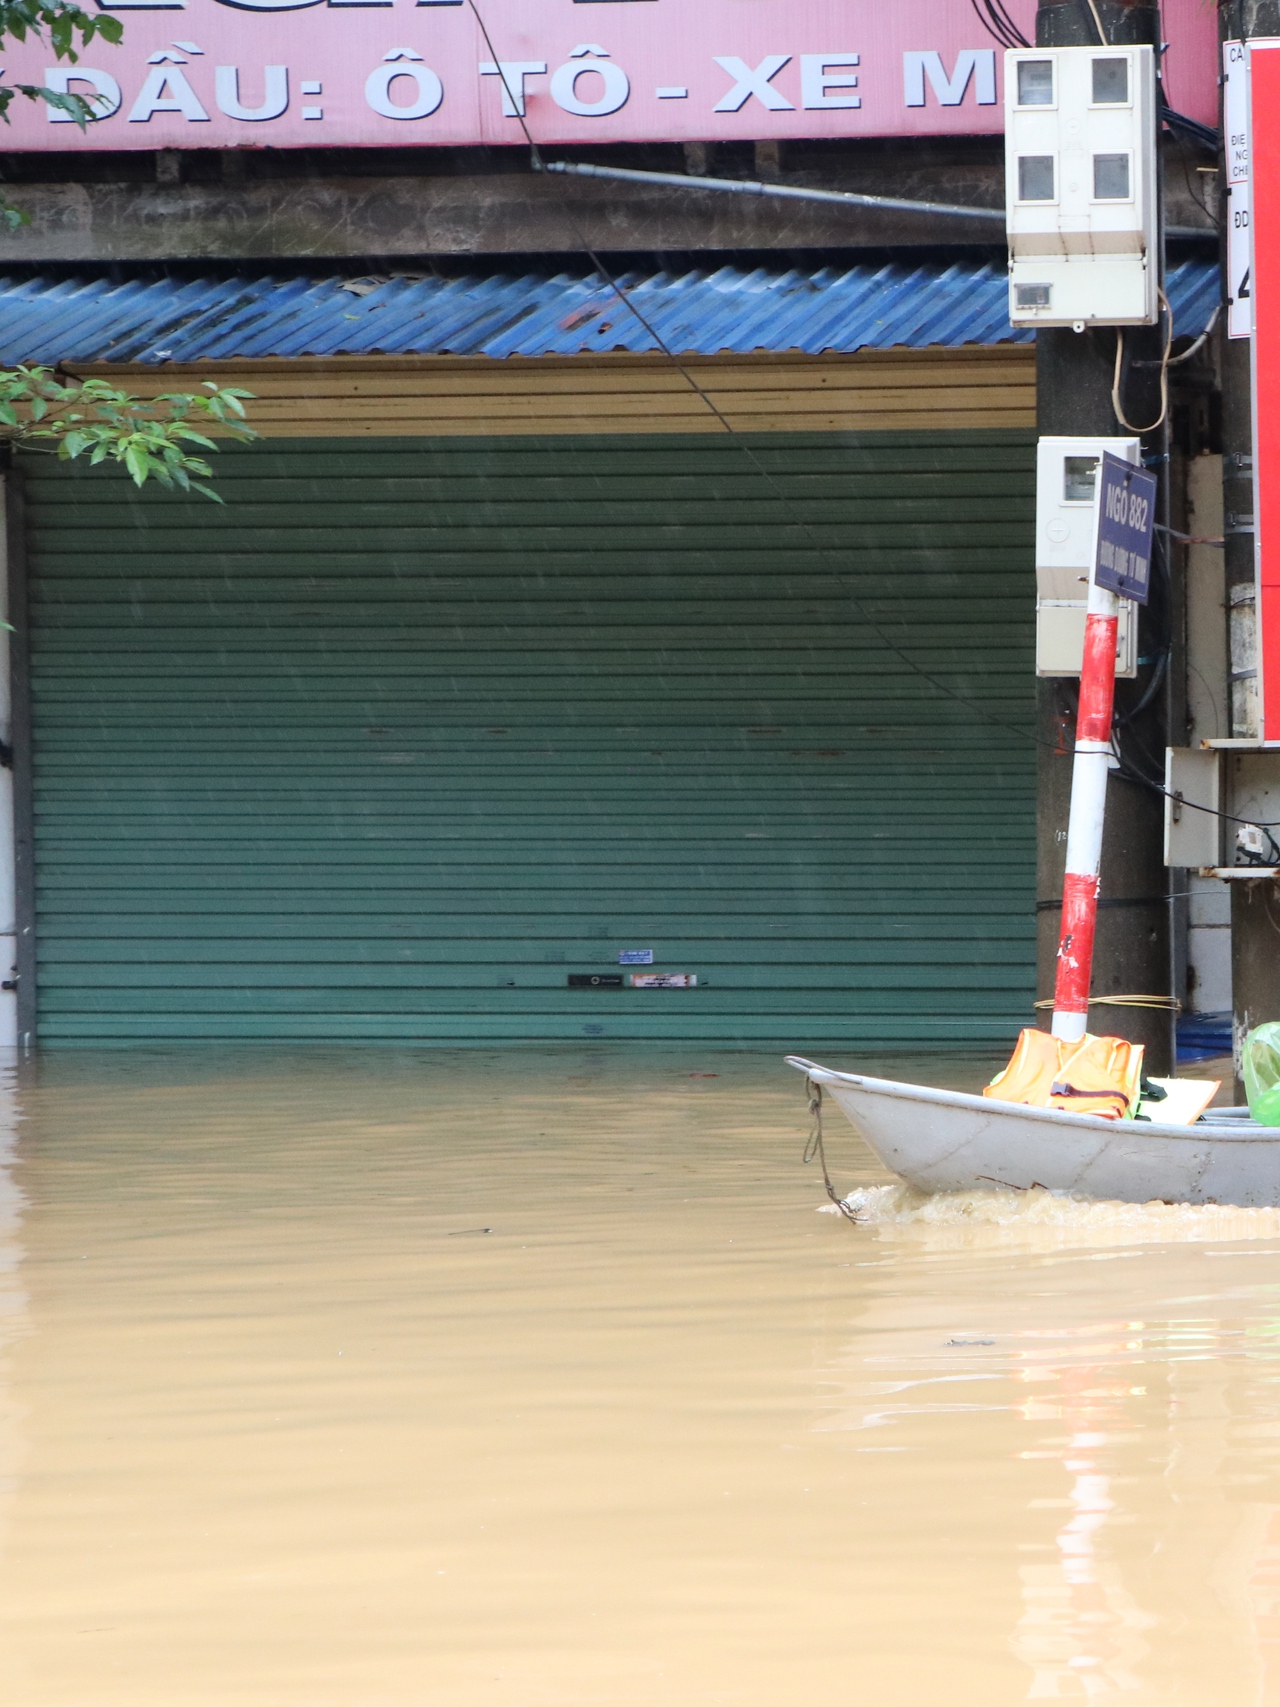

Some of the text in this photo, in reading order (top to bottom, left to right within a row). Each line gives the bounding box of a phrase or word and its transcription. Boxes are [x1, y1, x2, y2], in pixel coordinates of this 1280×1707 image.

[45, 41, 323, 123] DẦU:
[364, 46, 444, 120] Ô
[479, 43, 631, 118] TÔ
[711, 53, 862, 112] XE
[1129, 496, 1149, 533] 882
